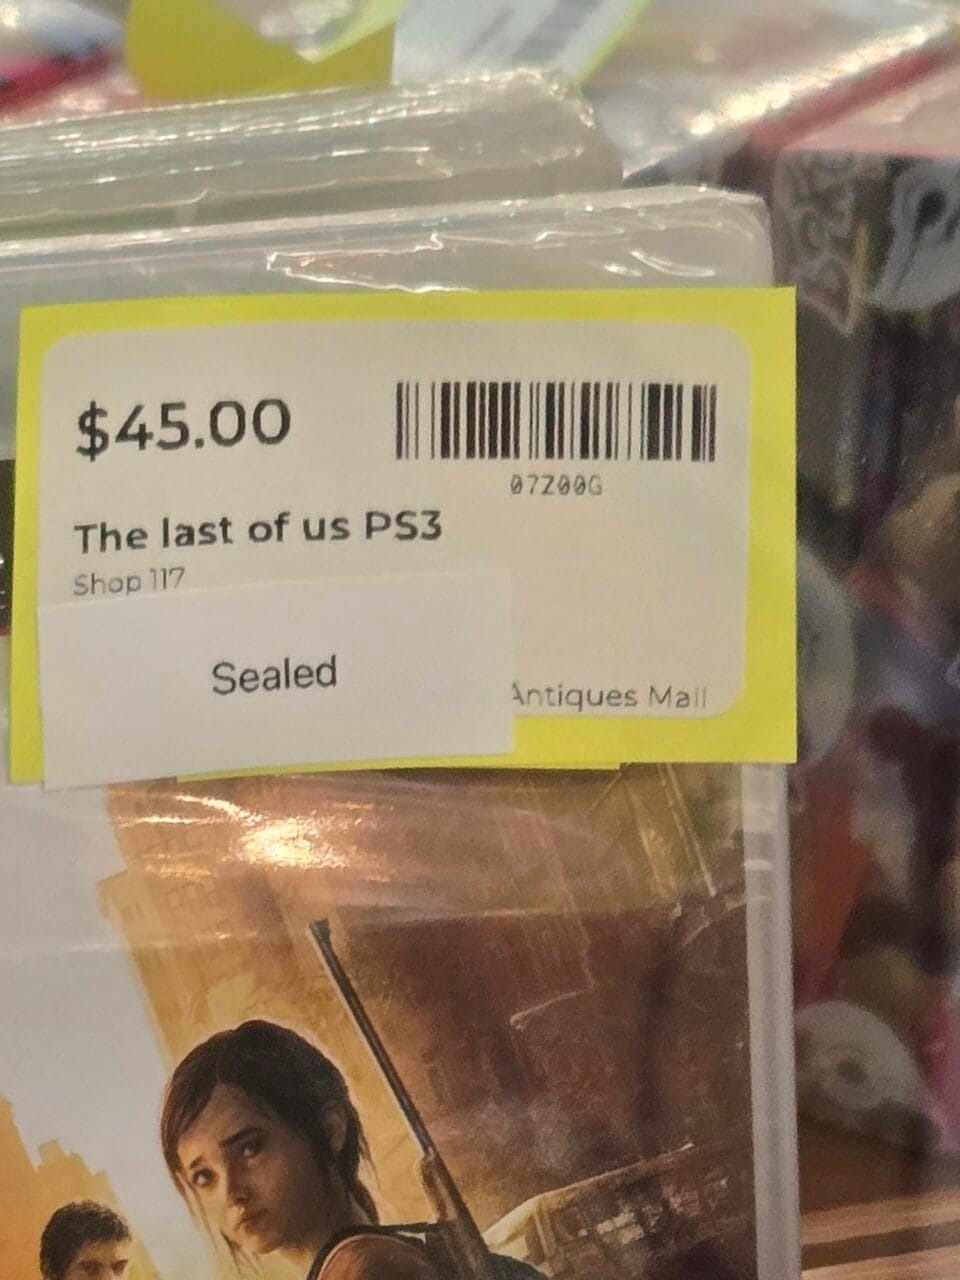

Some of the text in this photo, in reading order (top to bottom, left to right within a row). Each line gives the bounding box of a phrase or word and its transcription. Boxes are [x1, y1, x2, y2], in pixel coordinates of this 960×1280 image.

[75, 397, 292, 463] $45.00
[73, 509, 443, 554] The last of us PS3
[72, 565, 187, 598] Shop 117
[211, 653, 338, 696] Sealed
[511, 680, 708, 713] Antiques Mall
